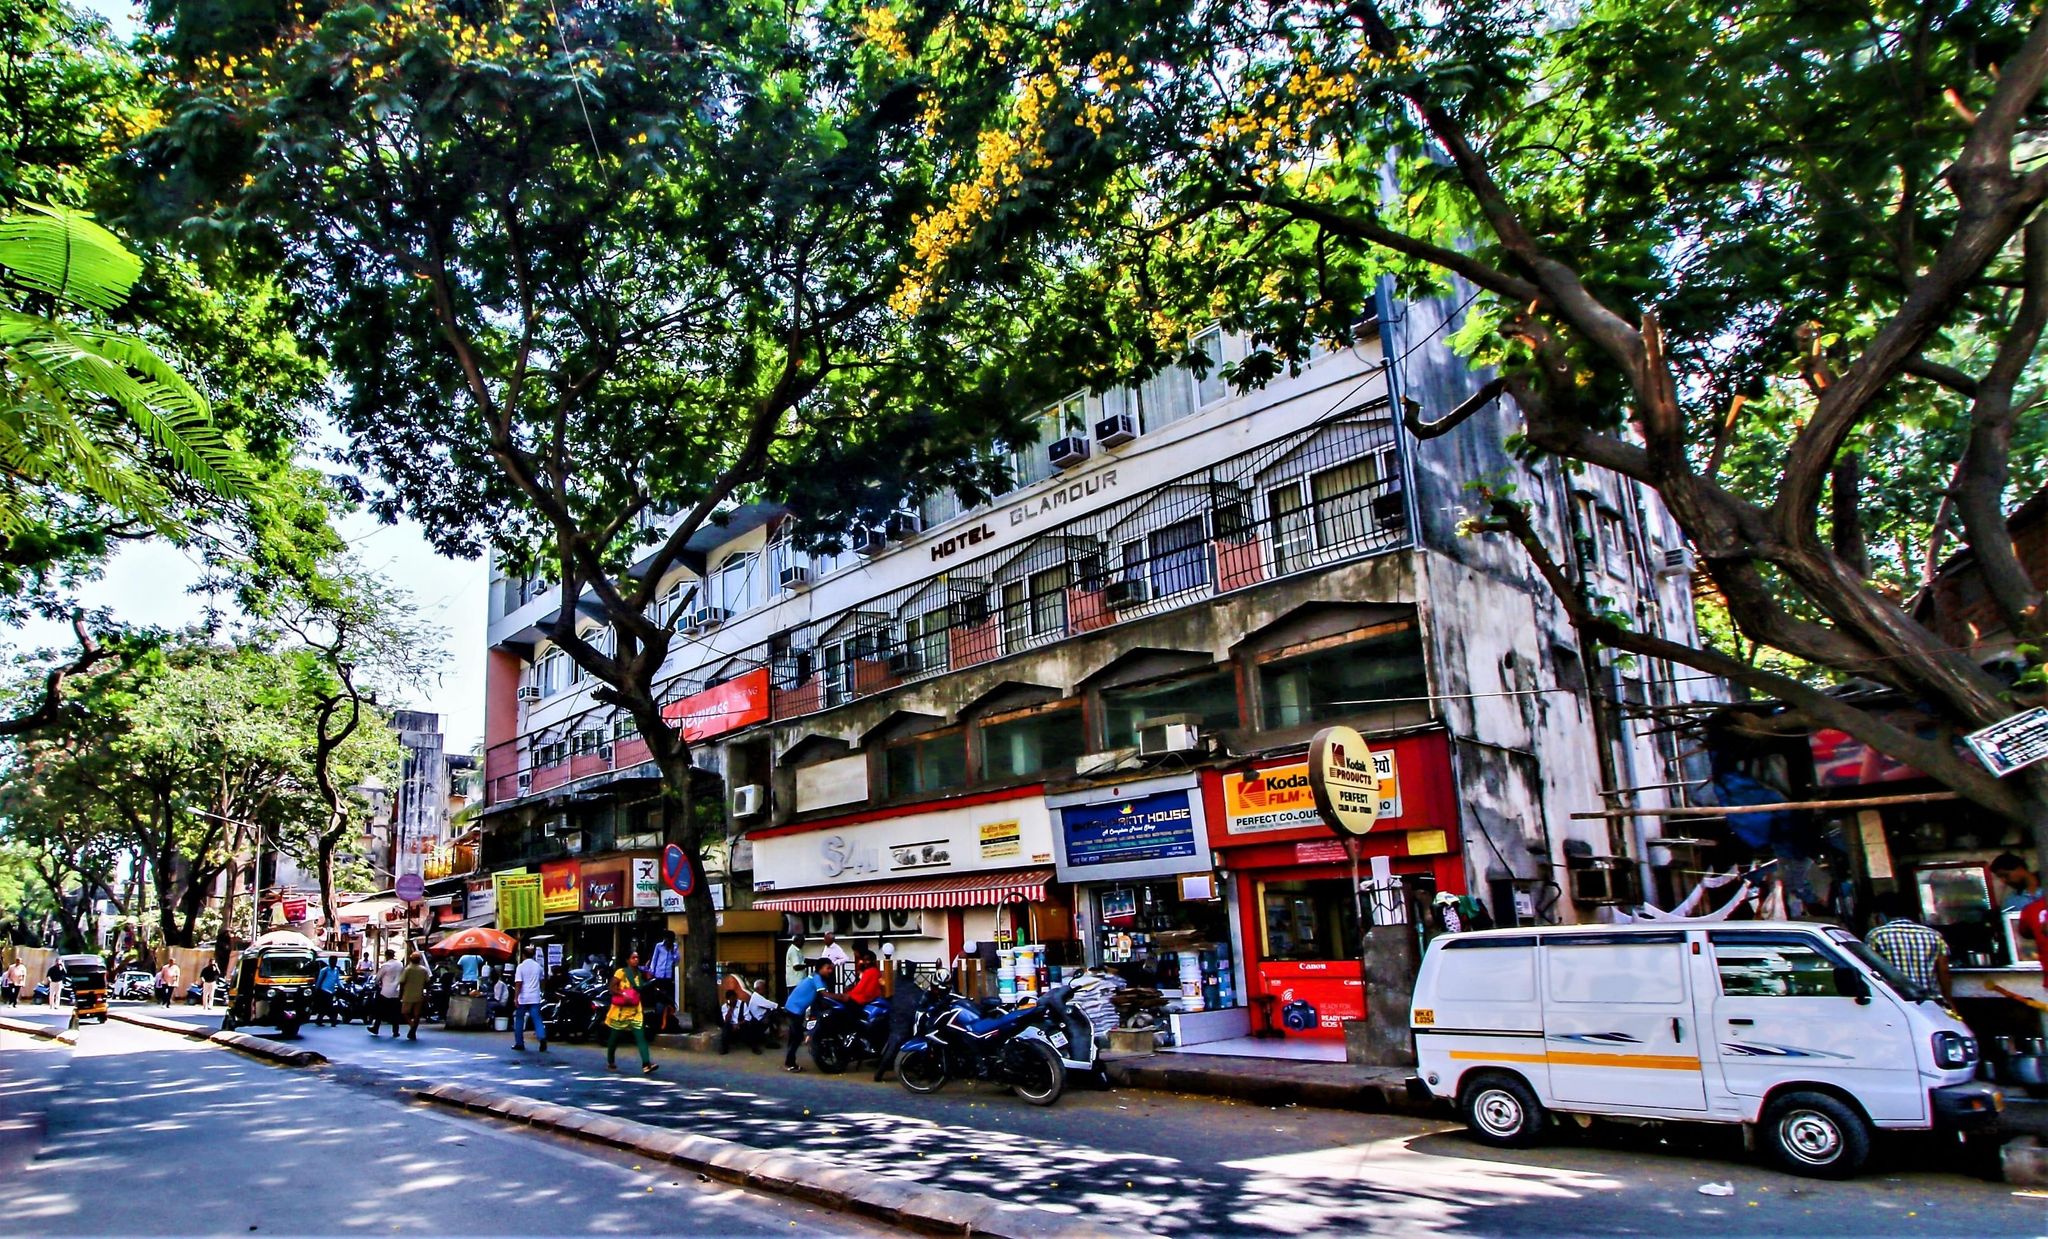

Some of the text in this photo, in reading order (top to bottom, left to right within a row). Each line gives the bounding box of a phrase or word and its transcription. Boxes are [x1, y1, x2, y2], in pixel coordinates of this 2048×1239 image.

[931, 470, 1117, 561] HOTEL GLAMOUR
[1346, 757, 1367, 772] Kodak
[1266, 775, 1309, 791] Koda
[1336, 769, 1372, 785] PRODUCTS
[1268, 790, 1299, 805] FILM
[1339, 791, 1368, 804] PERFECT
[1148, 808, 1190, 823] HOUSE
[1236, 814, 1279, 826] PERFECT
